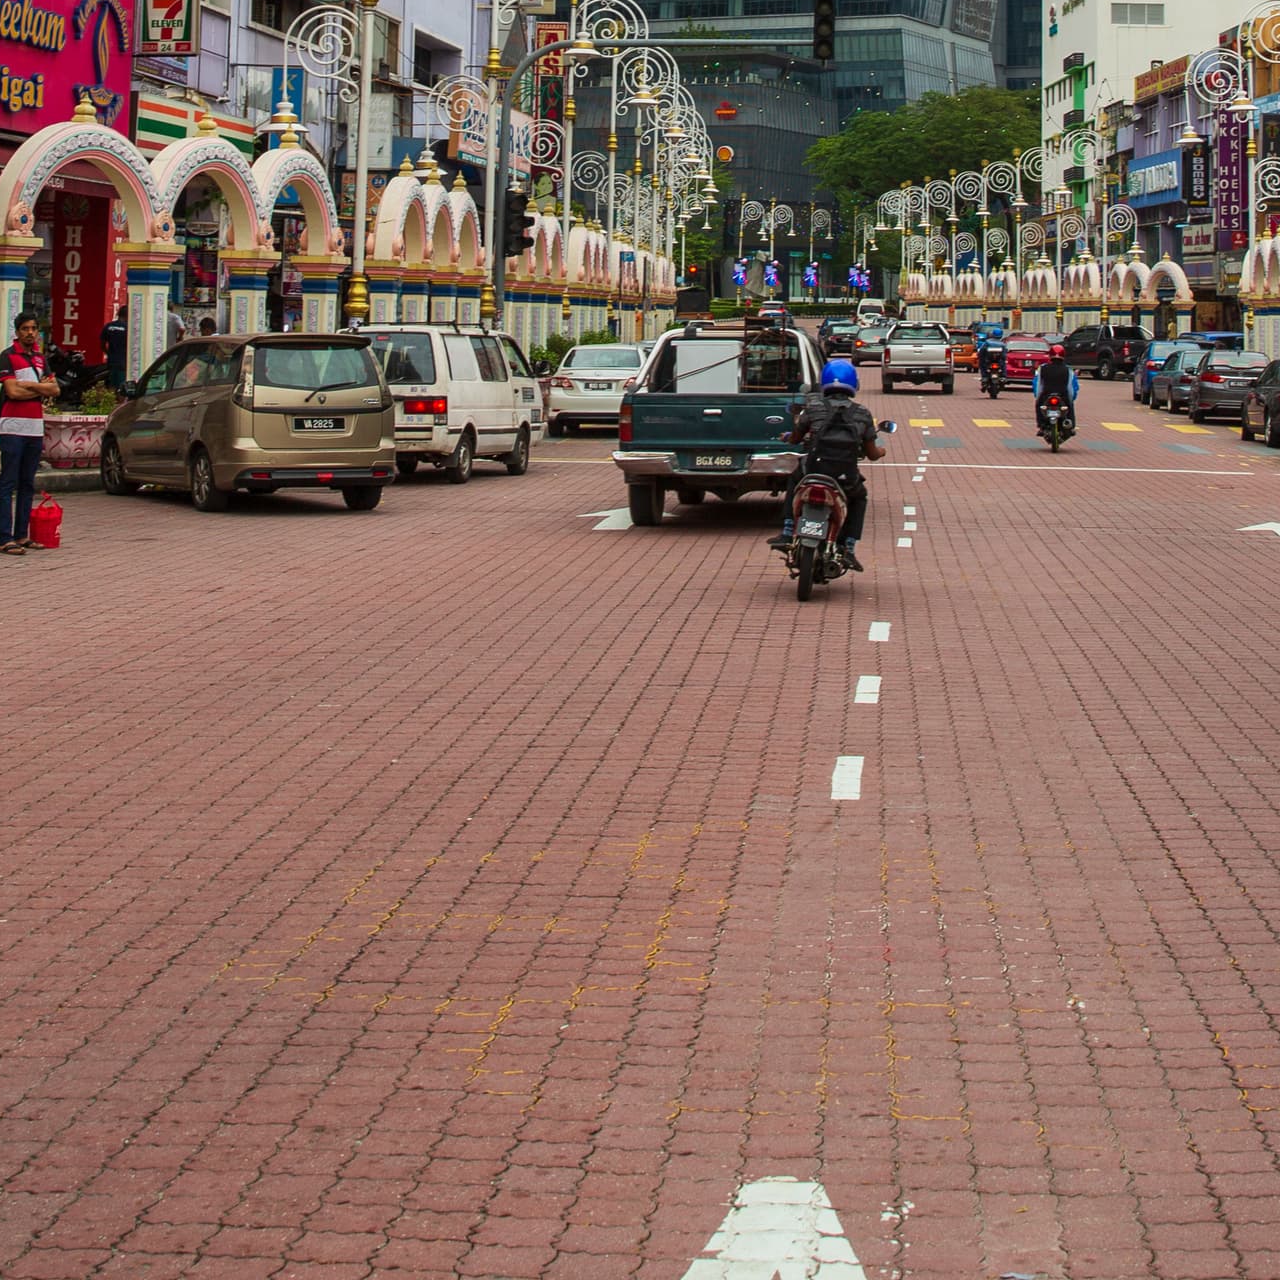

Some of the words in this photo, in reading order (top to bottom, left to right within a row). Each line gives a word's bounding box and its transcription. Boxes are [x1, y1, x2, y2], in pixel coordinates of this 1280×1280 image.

[161, 43, 173, 53] 24
[1192, 157, 1205, 199] BOMBAY
[1230, 88, 1241, 229] BICKFIELDS
[1219, 166, 1229, 229] HOTEL
[62, 225, 84, 347] HOTEL
[695, 456, 713, 467] BGX
[714, 456, 732, 467] 466
